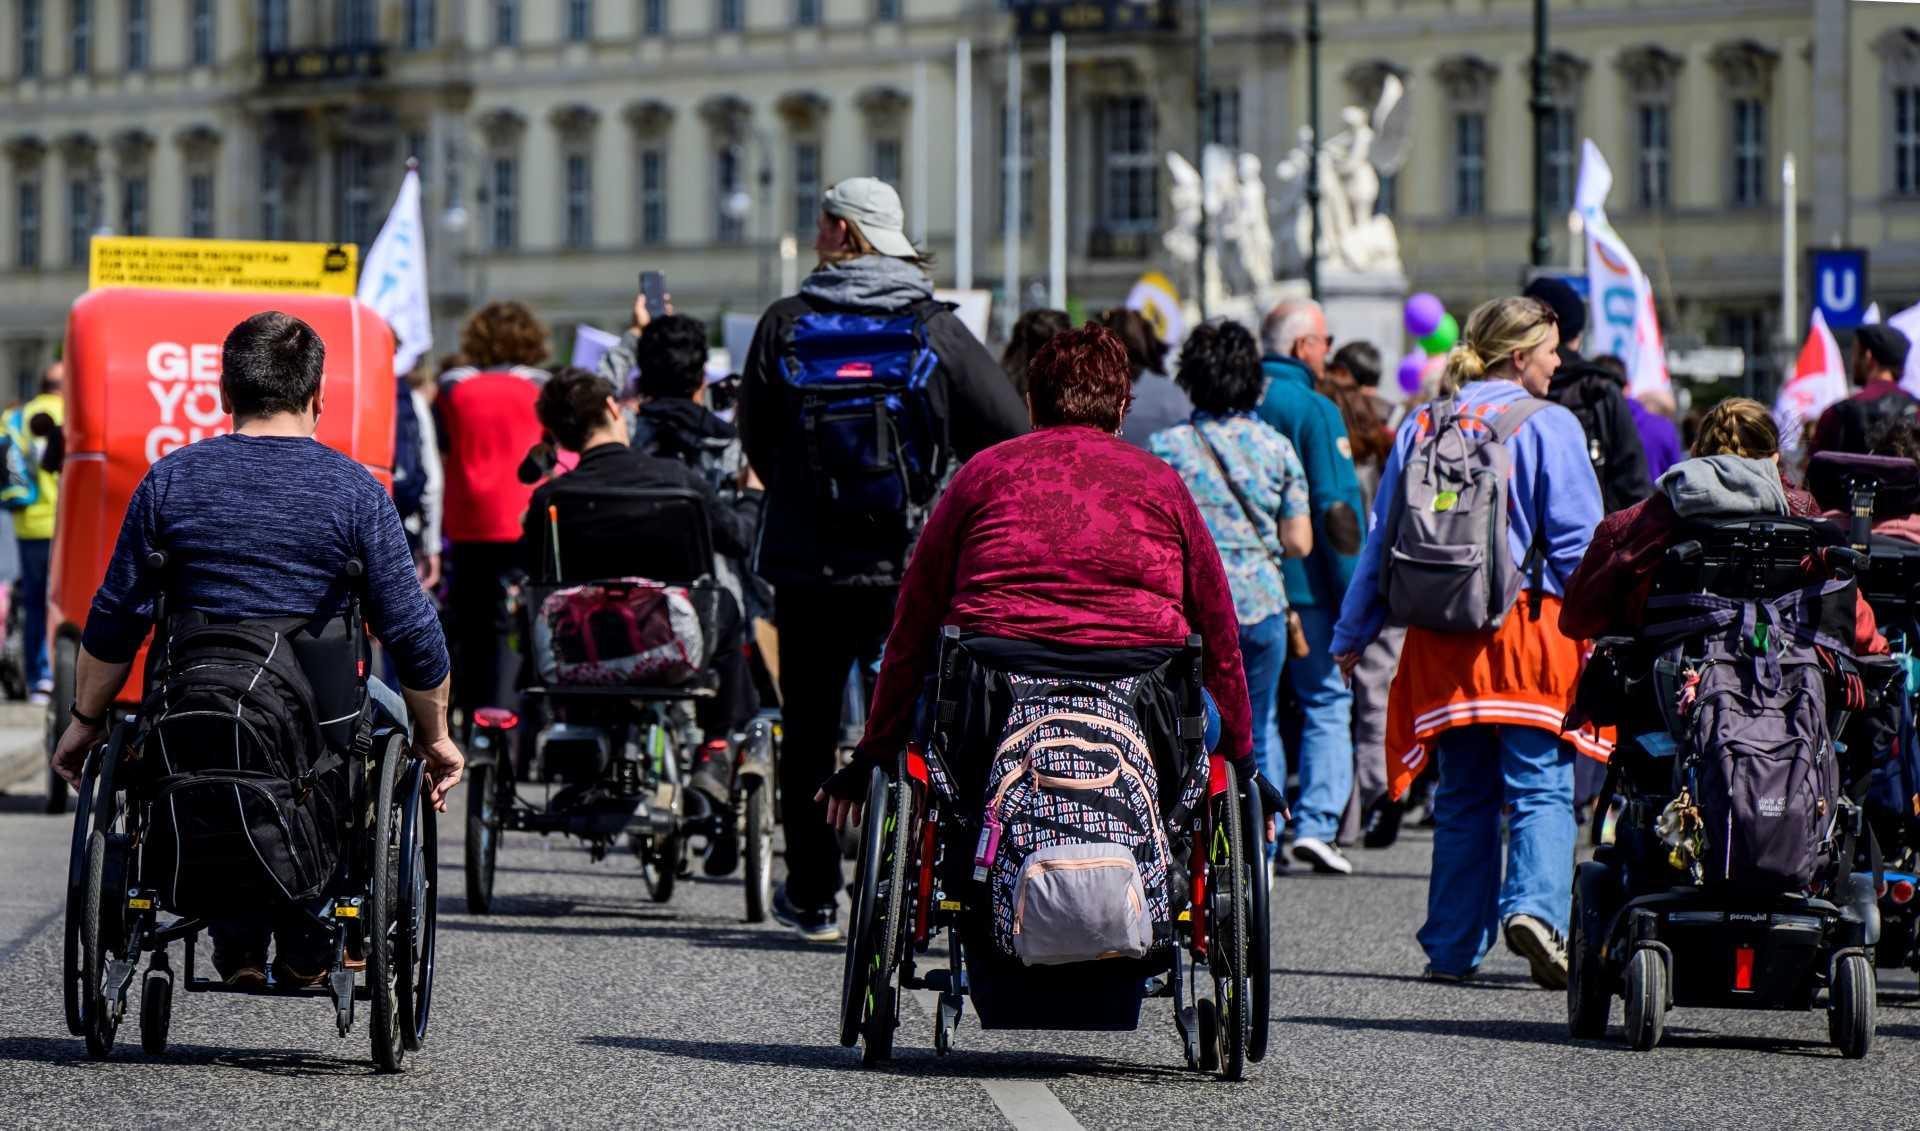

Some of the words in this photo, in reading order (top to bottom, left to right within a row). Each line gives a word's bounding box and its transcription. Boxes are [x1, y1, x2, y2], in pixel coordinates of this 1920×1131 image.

[1822, 269, 1856, 312] U
[146, 342, 224, 382] GE
[1097, 708, 1117, 720] ROXY
[1119, 714, 1138, 730] ROXY
[1040, 727, 1061, 738] ROXY
[1049, 760, 1072, 772] ROXY
[1074, 760, 1096, 772] ROXY
[1128, 752, 1146, 769] ROXY
[1011, 783, 1028, 803] ROXY
[1033, 794, 1053, 808] ROXY
[1034, 806, 1055, 818] ROXY
[1057, 801, 1080, 814] ROXY
[1058, 812, 1081, 825] ROXY
[1083, 811, 1105, 823] ROXY
[1012, 823, 1032, 835] ROXY
[1084, 821, 1106, 833] ROXY
[1108, 821, 1129, 833] ROXY
[1013, 832, 1034, 847] ROXY
[1036, 828, 1056, 843] ROXY
[1110, 832, 1129, 844] ROXY
[1729, 912, 1767, 922] permobil
